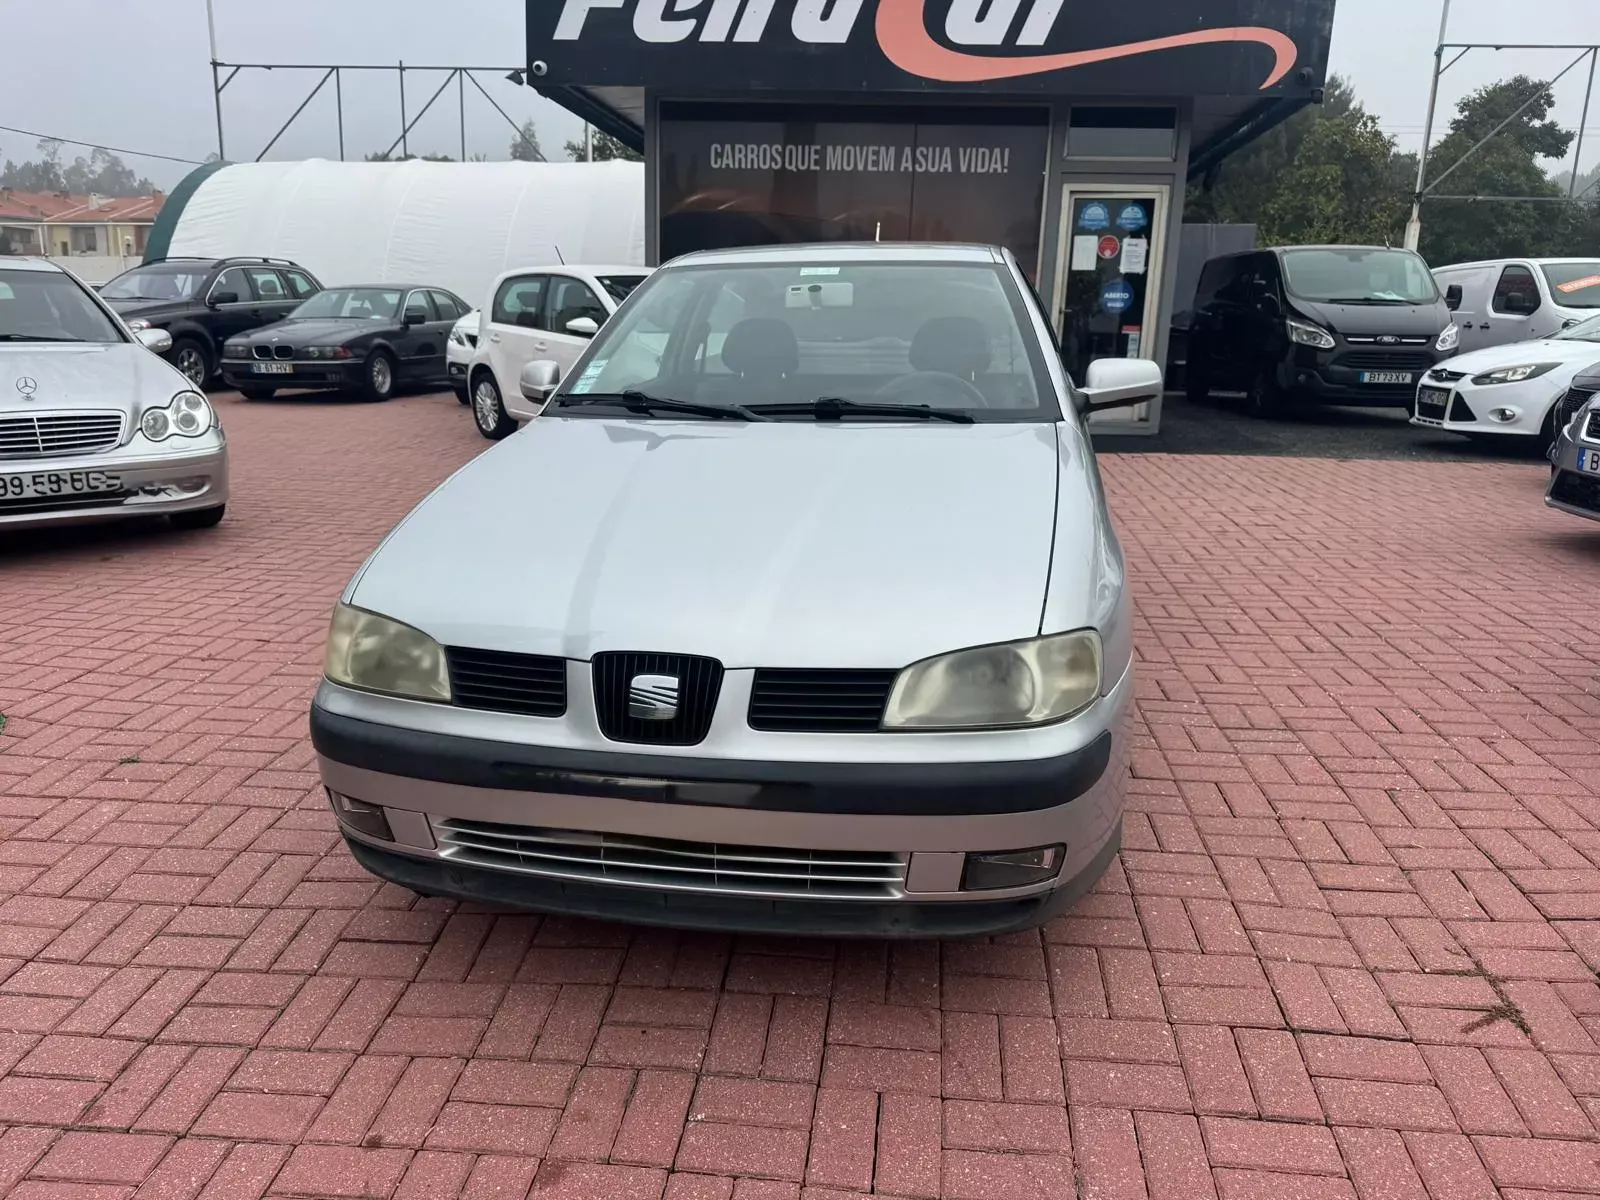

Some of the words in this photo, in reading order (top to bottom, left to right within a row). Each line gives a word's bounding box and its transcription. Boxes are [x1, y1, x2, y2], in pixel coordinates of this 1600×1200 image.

[710, 143, 782, 170] CARROS
[784, 145, 821, 172] QUE
[826, 145, 895, 172] MOVEM
[900, 146, 913, 172] A
[915, 146, 952, 173] SUA
[959, 147, 1010, 174] VIDA!
